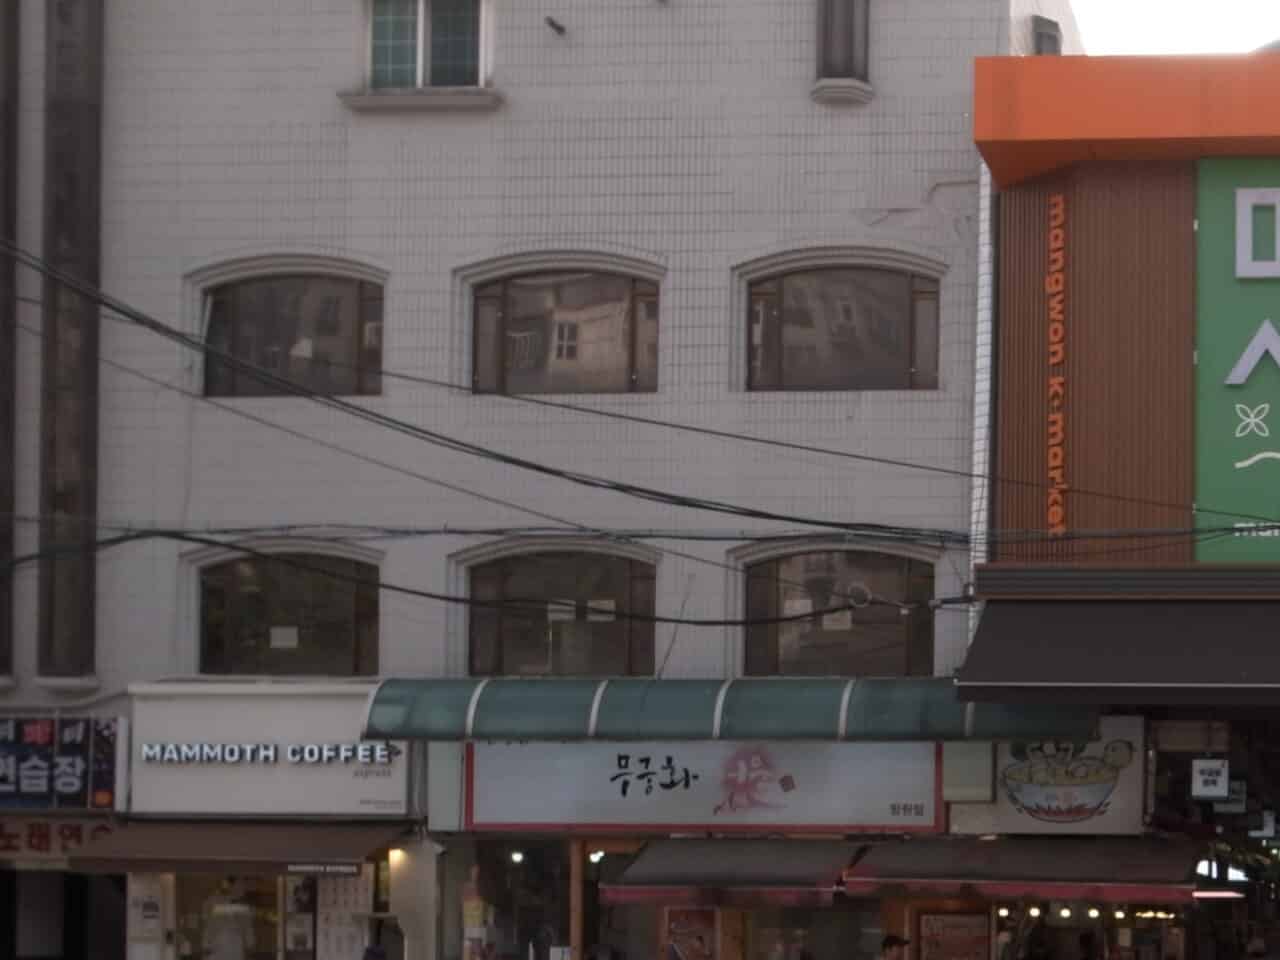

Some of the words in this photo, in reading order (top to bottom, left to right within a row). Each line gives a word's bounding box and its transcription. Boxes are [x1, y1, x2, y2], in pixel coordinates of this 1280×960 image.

[1044, 195, 1065, 366] mangwon
[141, 743, 276, 763] MAMMOTH
[287, 743, 391, 763] COFFEE
[610, 753, 699, 797] 무궁화
